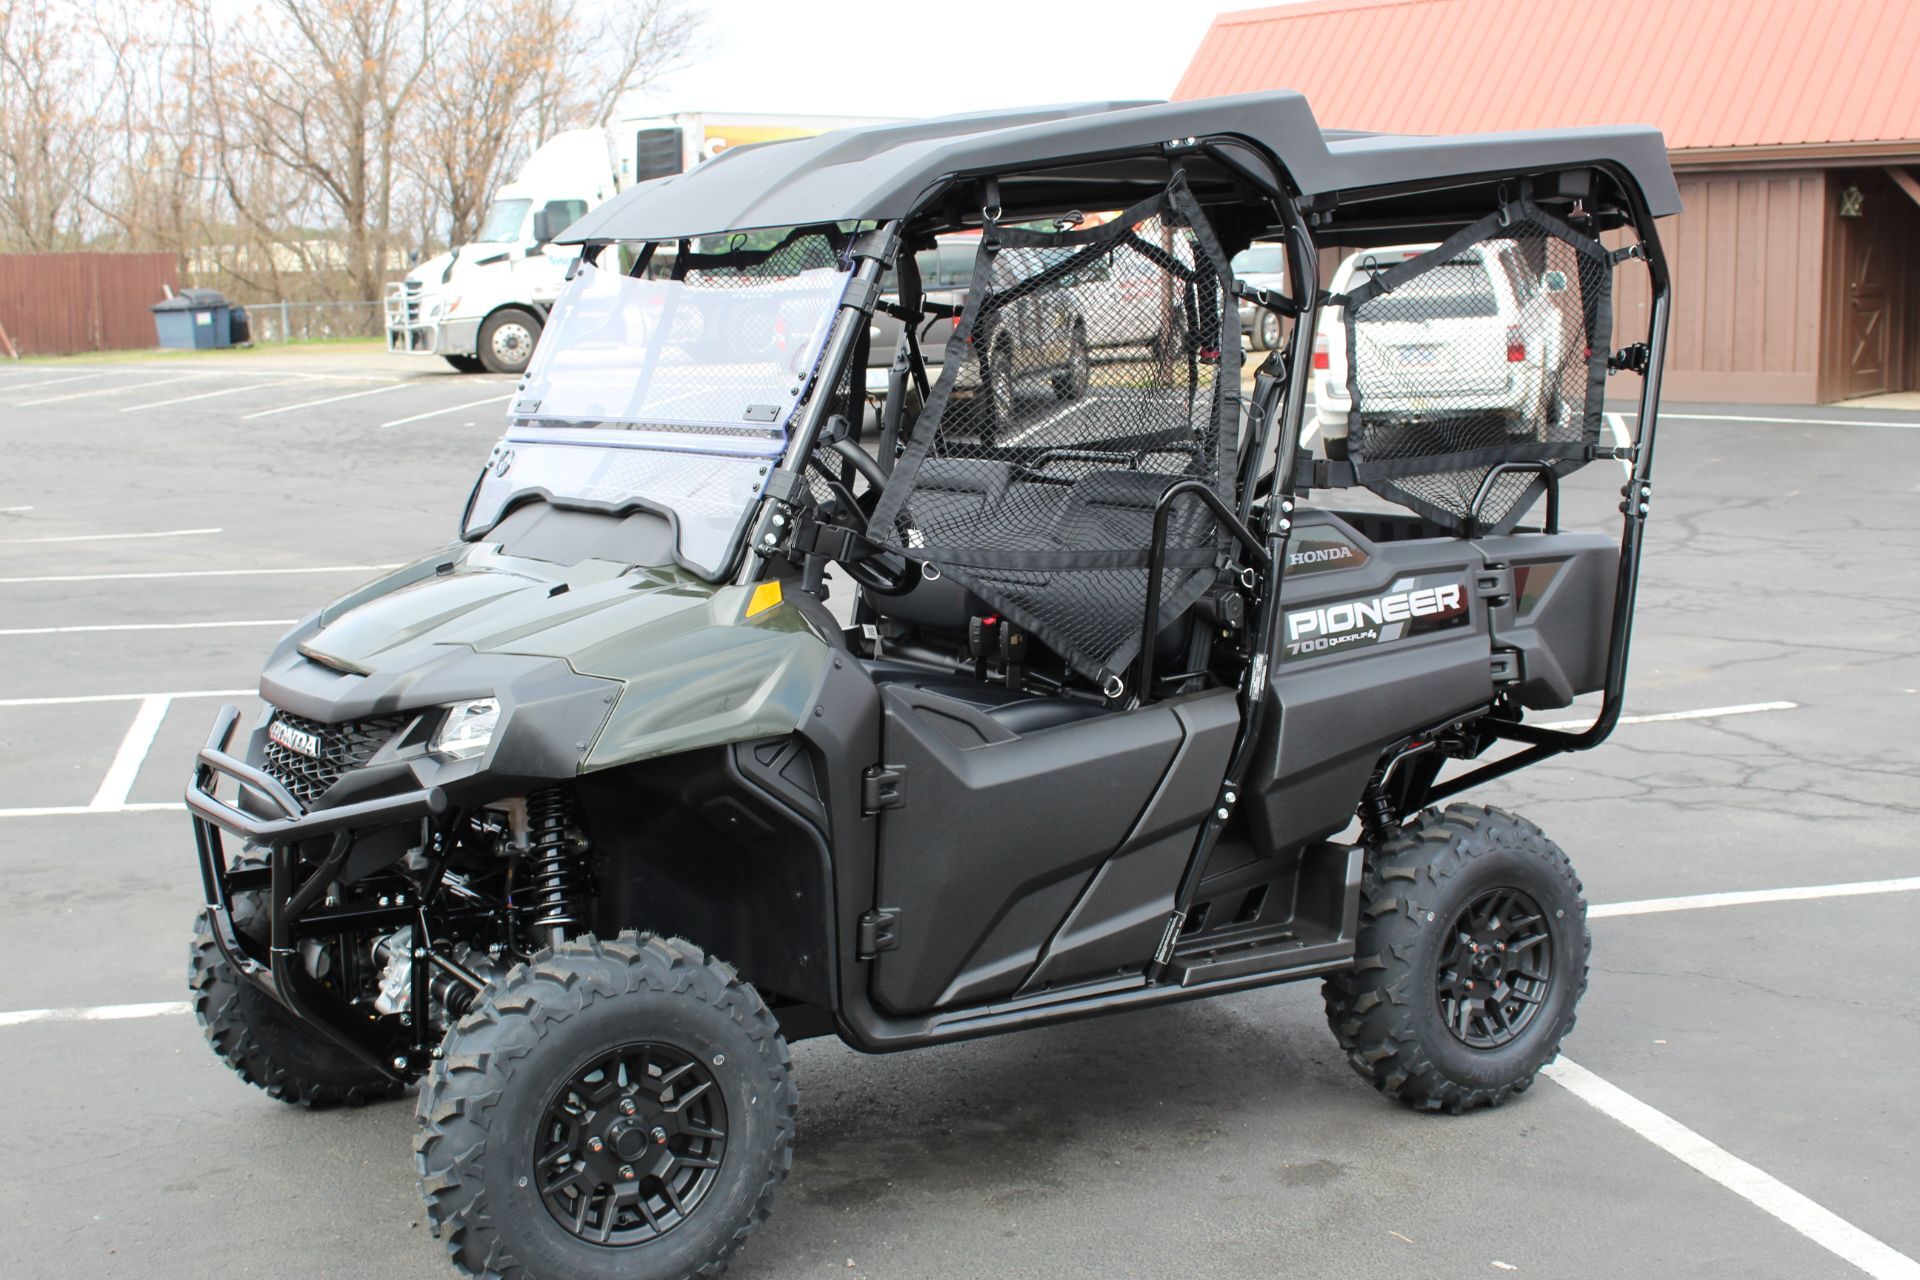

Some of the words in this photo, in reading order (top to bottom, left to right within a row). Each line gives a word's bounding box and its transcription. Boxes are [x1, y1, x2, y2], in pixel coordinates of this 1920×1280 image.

[1289, 546, 1352, 565] HONDA
[1288, 584, 1460, 641] PIONEER
[1287, 638, 1329, 656] 700
[270, 720, 318, 758] HONDA
